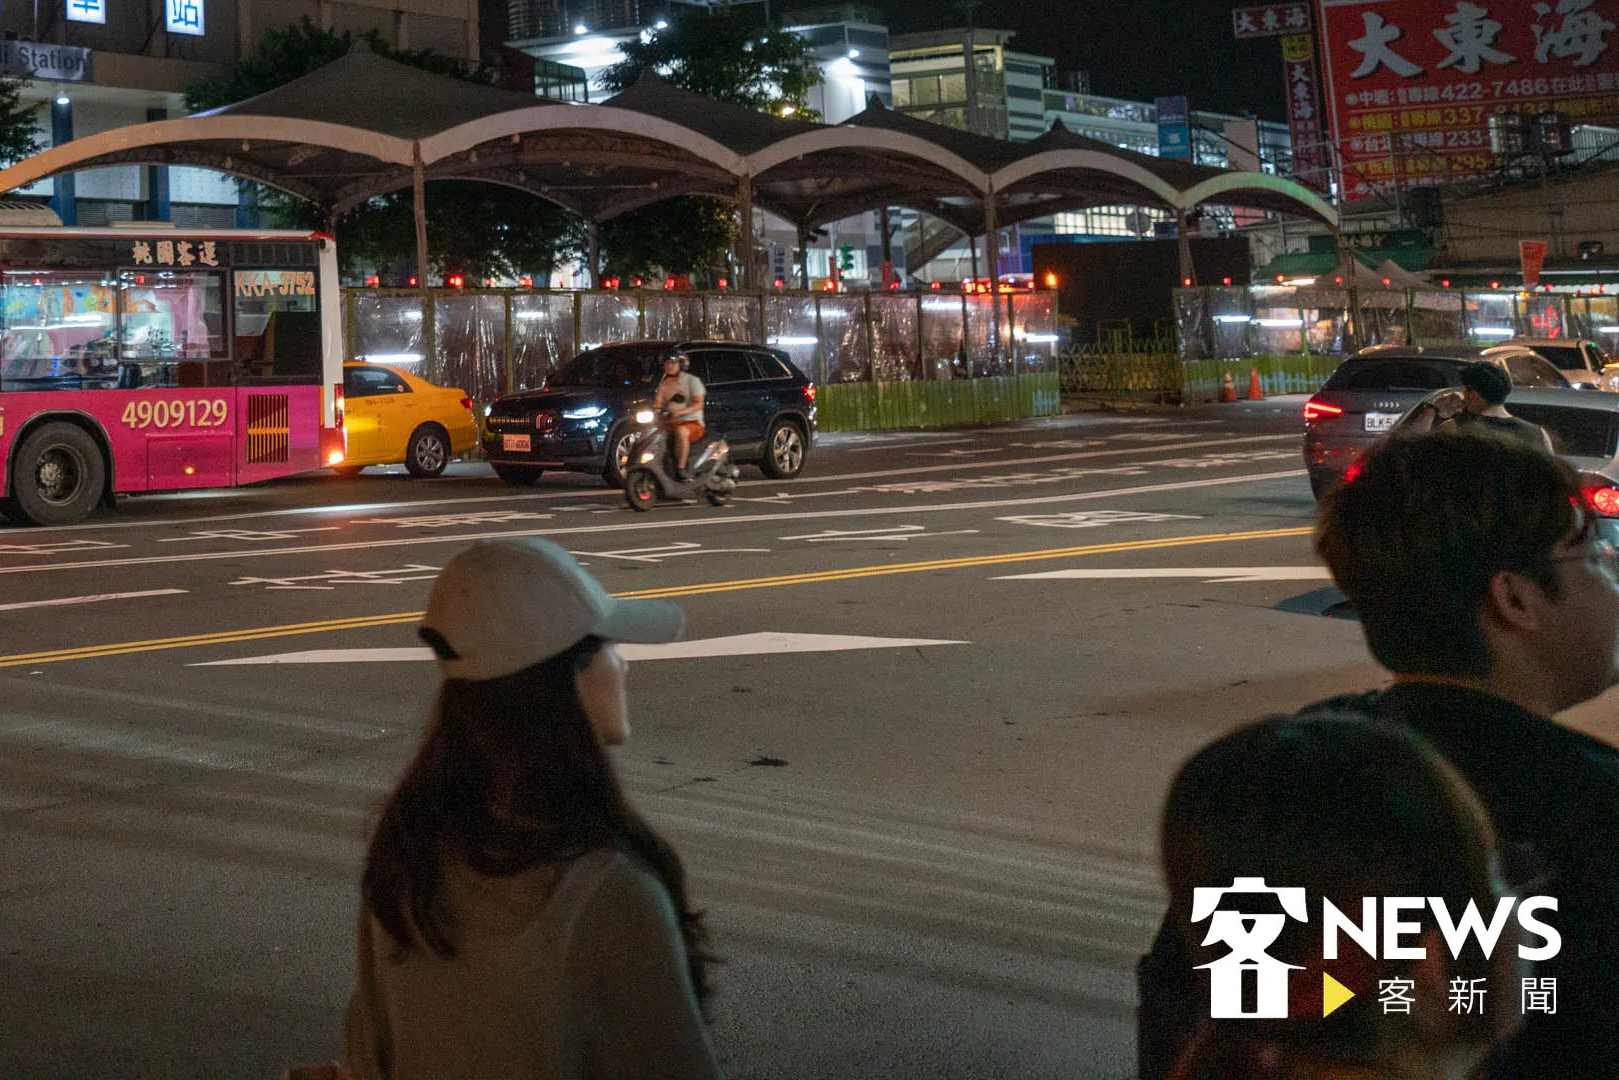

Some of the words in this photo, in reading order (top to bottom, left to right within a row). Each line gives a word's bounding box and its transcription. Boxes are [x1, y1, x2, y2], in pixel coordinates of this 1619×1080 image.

[1236, 6, 1307, 33] 大東海
[18, 46, 87, 71] Station
[1291, 63, 1315, 120] 大東海
[132, 240, 220, 268] 桃園客運
[234, 271, 316, 297] KKA-3752
[121, 398, 229, 429] 4909129
